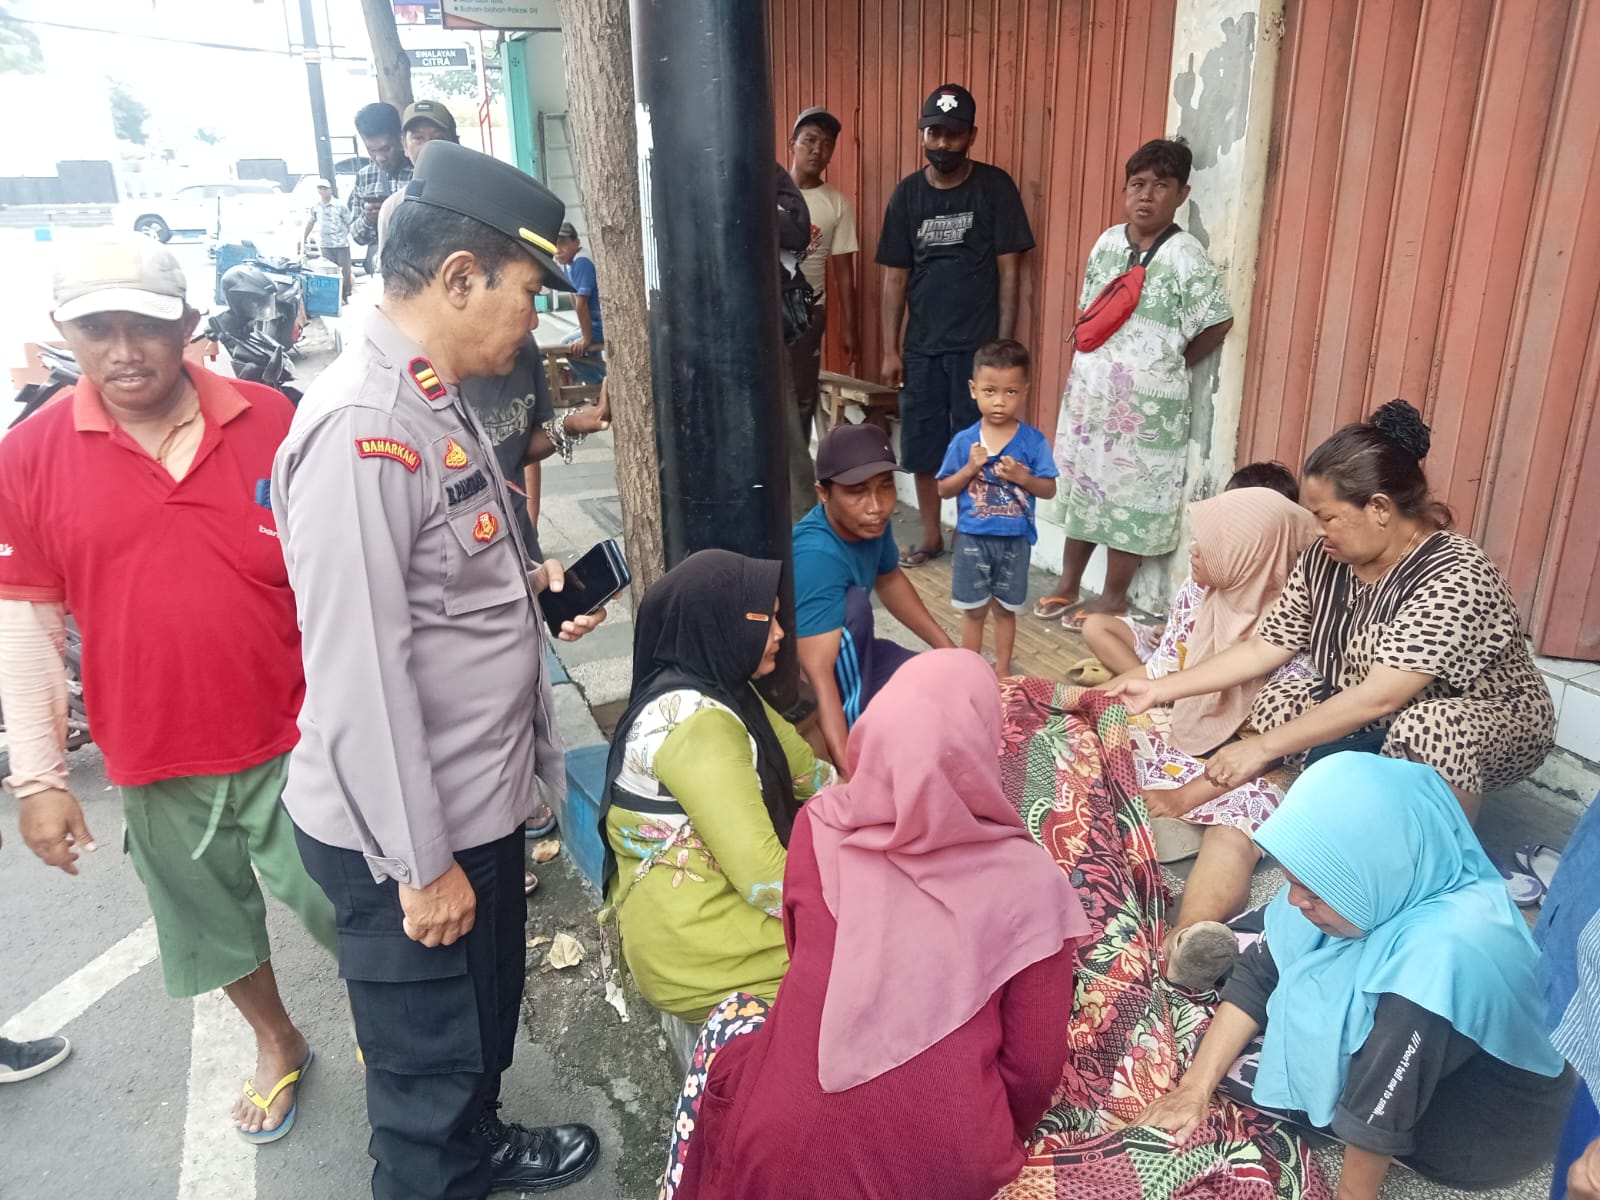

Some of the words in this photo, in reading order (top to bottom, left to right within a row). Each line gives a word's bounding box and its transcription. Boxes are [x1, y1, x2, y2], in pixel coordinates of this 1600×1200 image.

[415, 49, 456, 58] SWALAYAN
[422, 57, 451, 66] CITRA
[361, 440, 417, 466] BAHARKAM
[1394, 1065, 1406, 1082] tell
[1387, 1078, 1398, 1092] me
[1383, 1090, 1393, 1100] to
